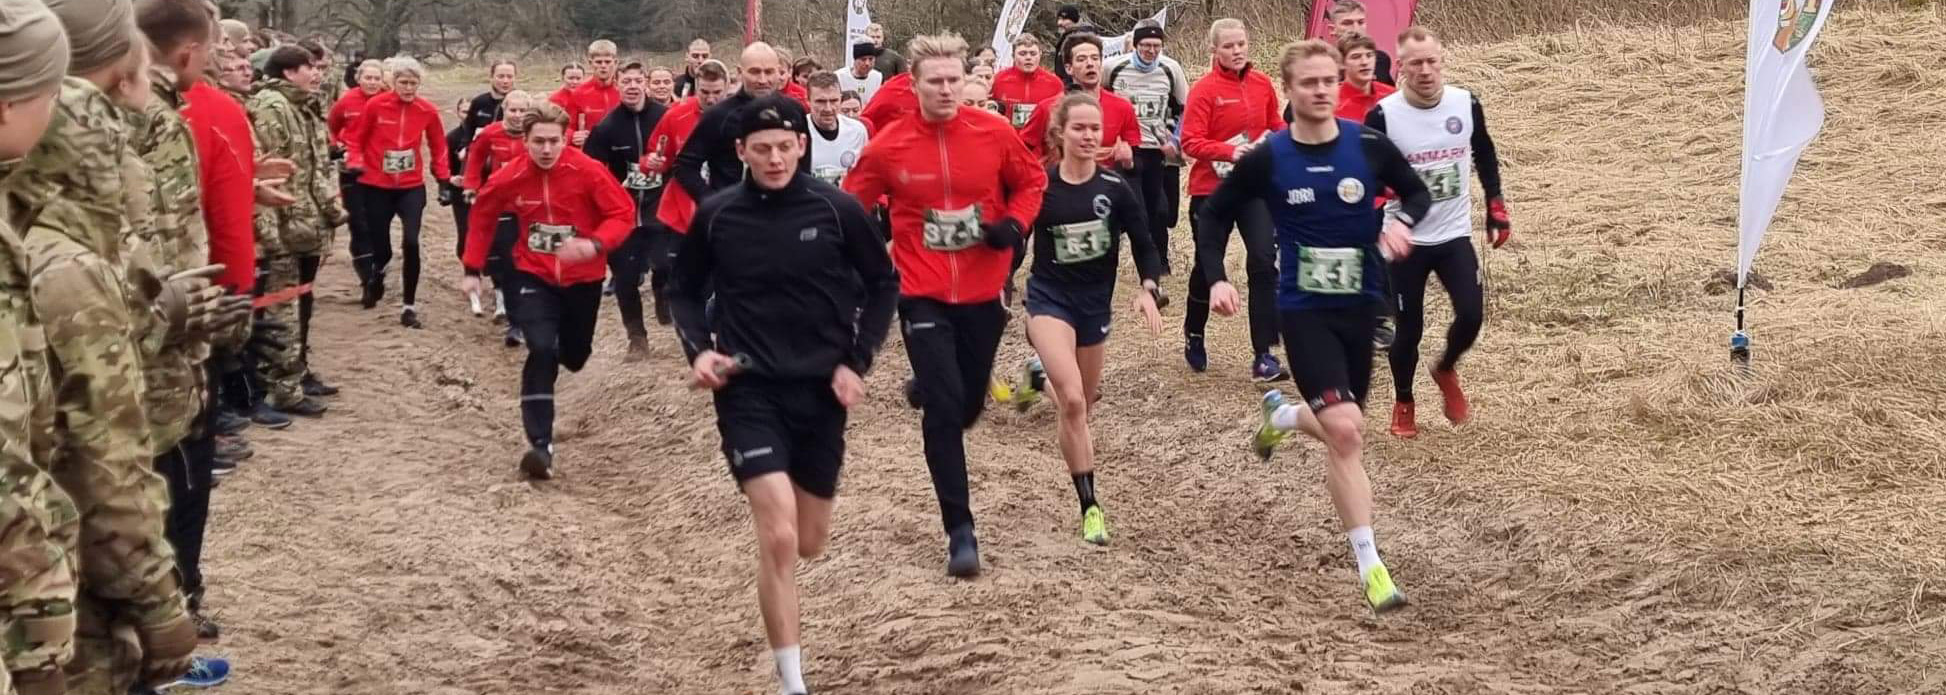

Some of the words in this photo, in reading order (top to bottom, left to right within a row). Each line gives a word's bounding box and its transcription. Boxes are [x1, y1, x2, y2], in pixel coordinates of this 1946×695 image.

[1407, 147, 1468, 163] ANMARK
[923, 217, 979, 246] 37-1
[1066, 233, 1104, 255] 6-1
[1312, 263, 1347, 290] 4-1
